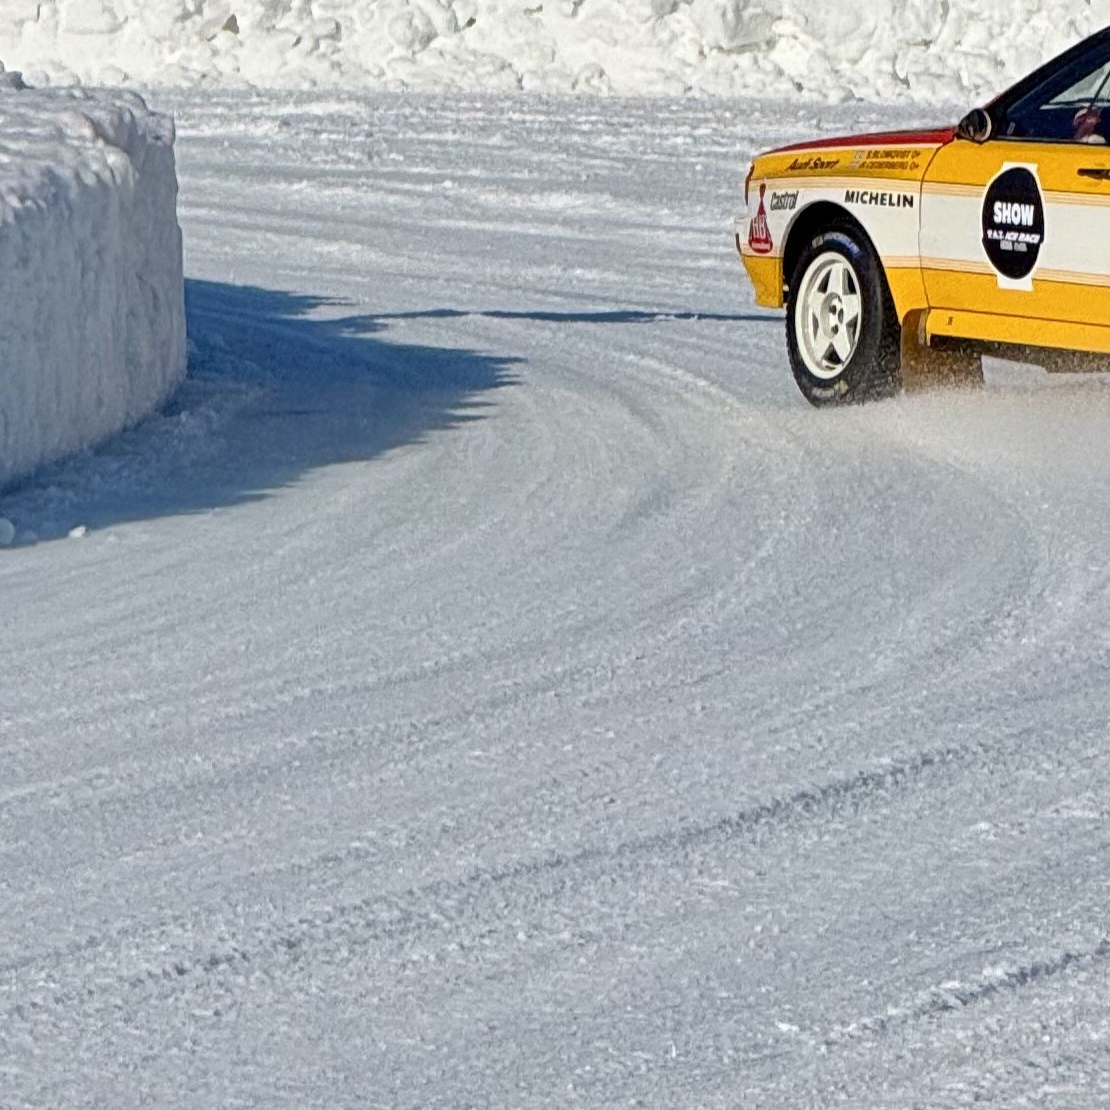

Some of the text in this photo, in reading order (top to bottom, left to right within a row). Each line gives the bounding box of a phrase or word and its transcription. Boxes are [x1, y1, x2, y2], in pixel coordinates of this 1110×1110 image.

[770, 190, 800, 210] Castrol
[844, 190, 914, 209] MICHELIN
[993, 200, 1035, 227] SHOW
